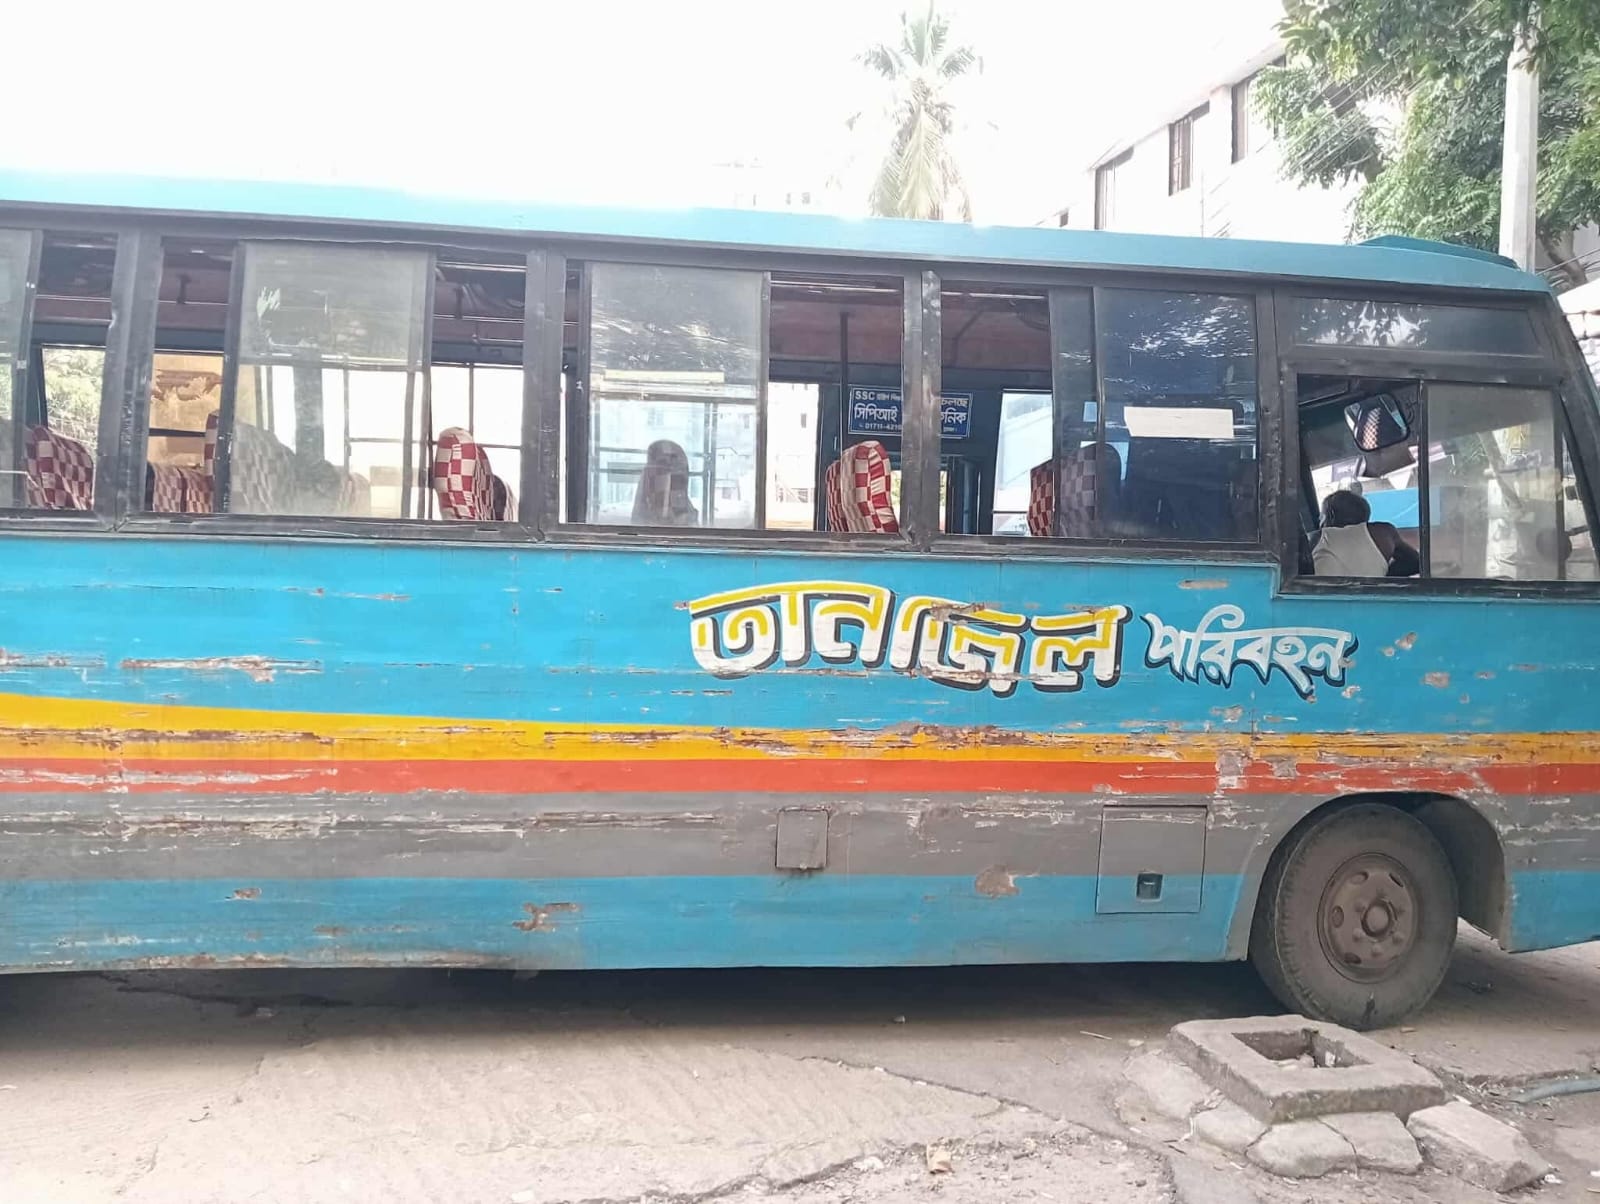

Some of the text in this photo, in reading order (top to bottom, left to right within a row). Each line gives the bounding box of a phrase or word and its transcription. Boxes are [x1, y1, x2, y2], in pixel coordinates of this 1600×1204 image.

[855, 390, 875, 400] SSC
[854, 402, 898, 422] সিপিআই
[690, 580, 1358, 700] তানজিল পরিবহন
